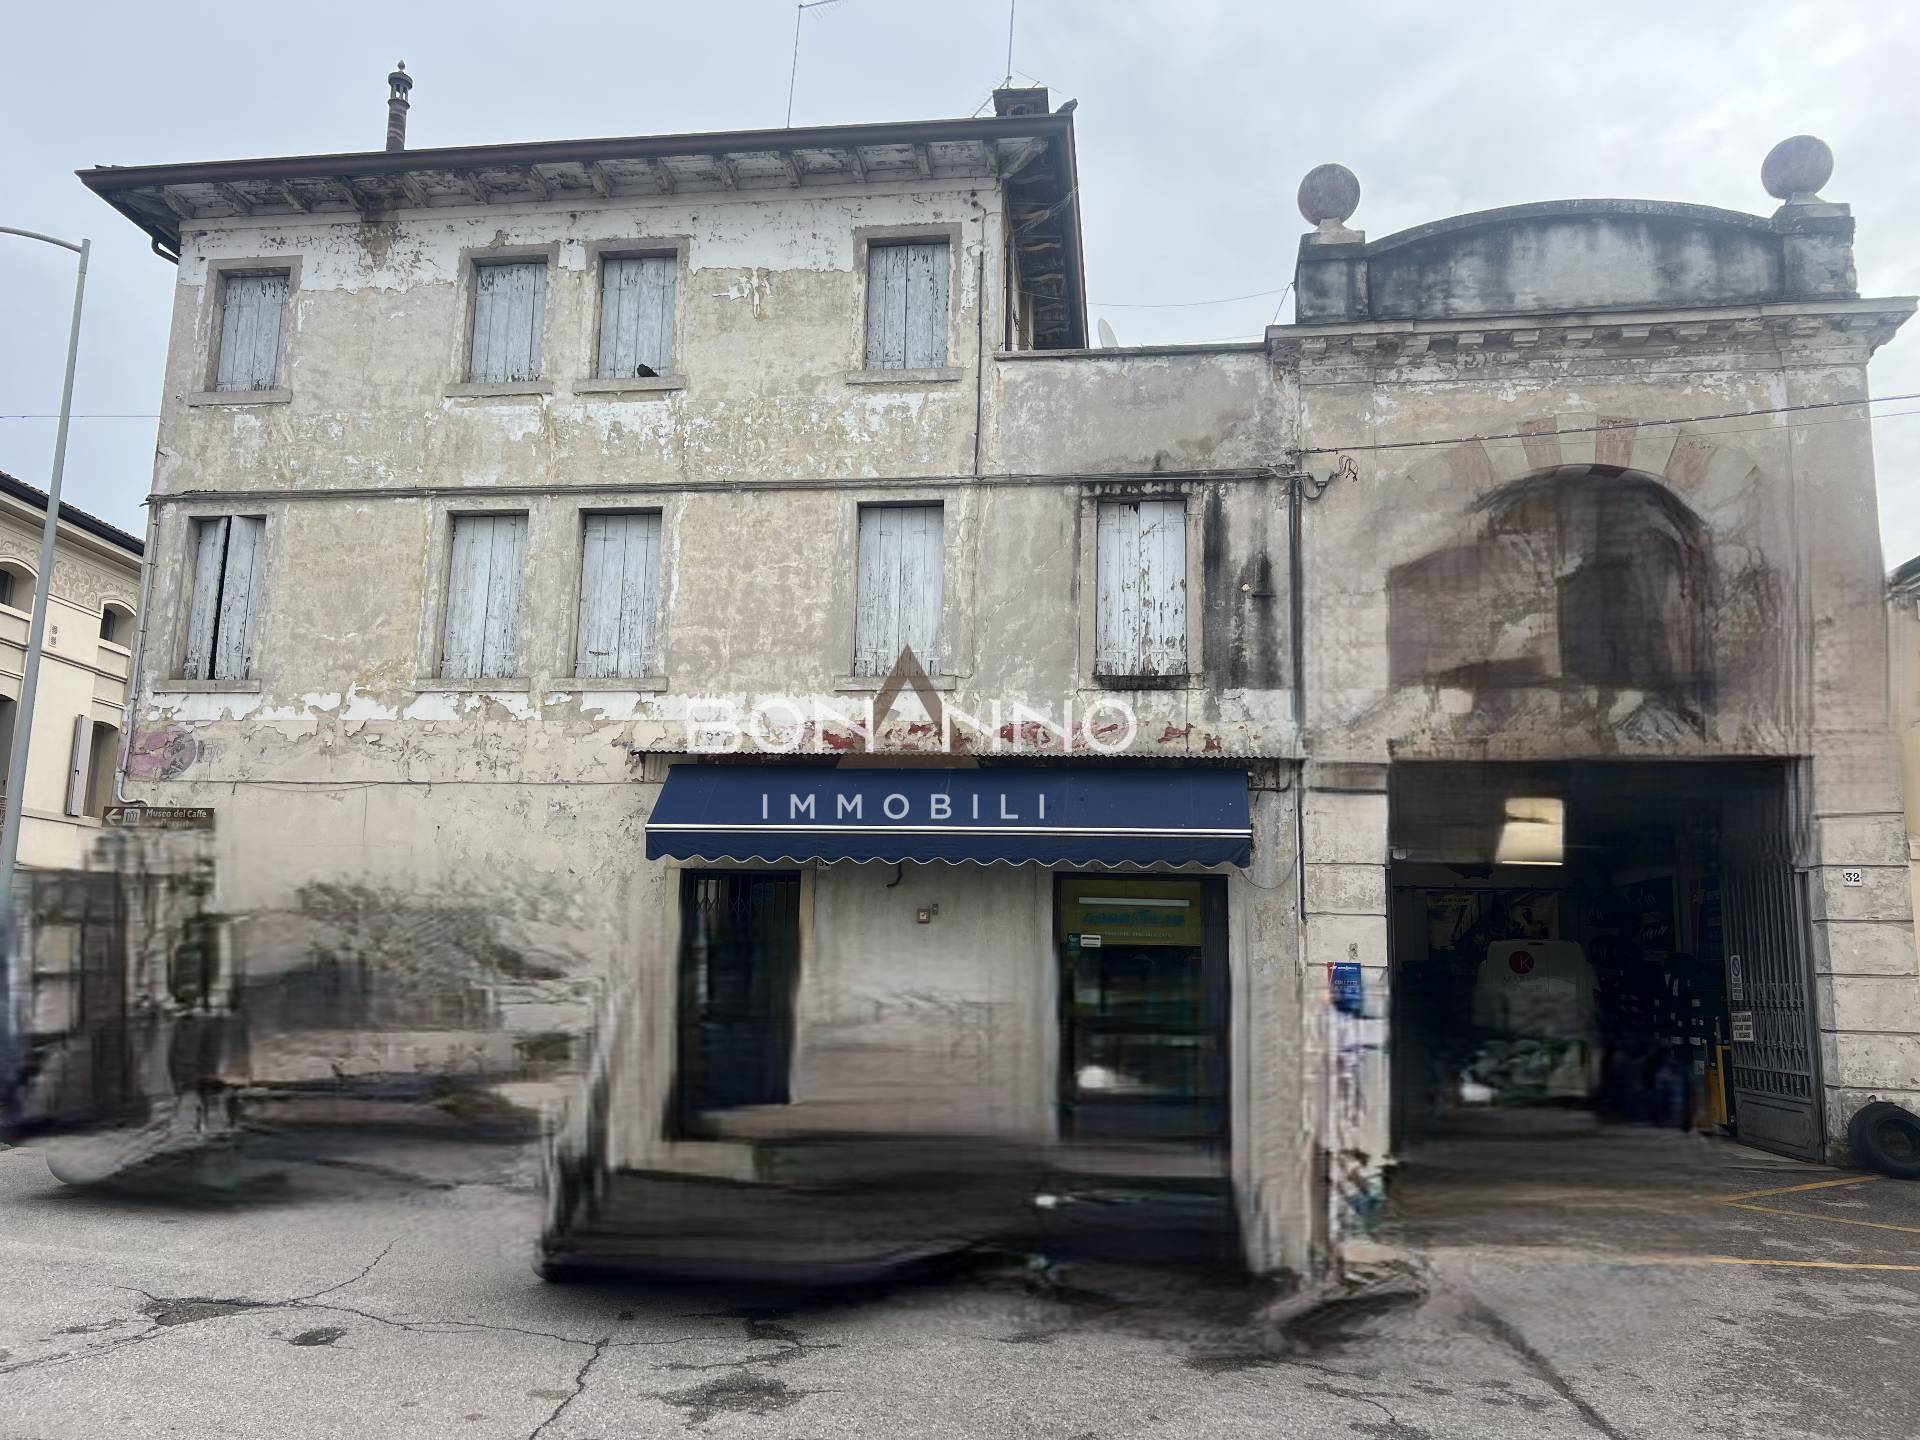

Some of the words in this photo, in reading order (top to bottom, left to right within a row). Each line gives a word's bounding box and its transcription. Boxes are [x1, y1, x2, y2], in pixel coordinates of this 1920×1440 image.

[145, 809, 171, 818] Museo
[173, 809, 186, 818] del
[187, 809, 207, 818] Caffè
[1845, 872, 1860, 882] 32
